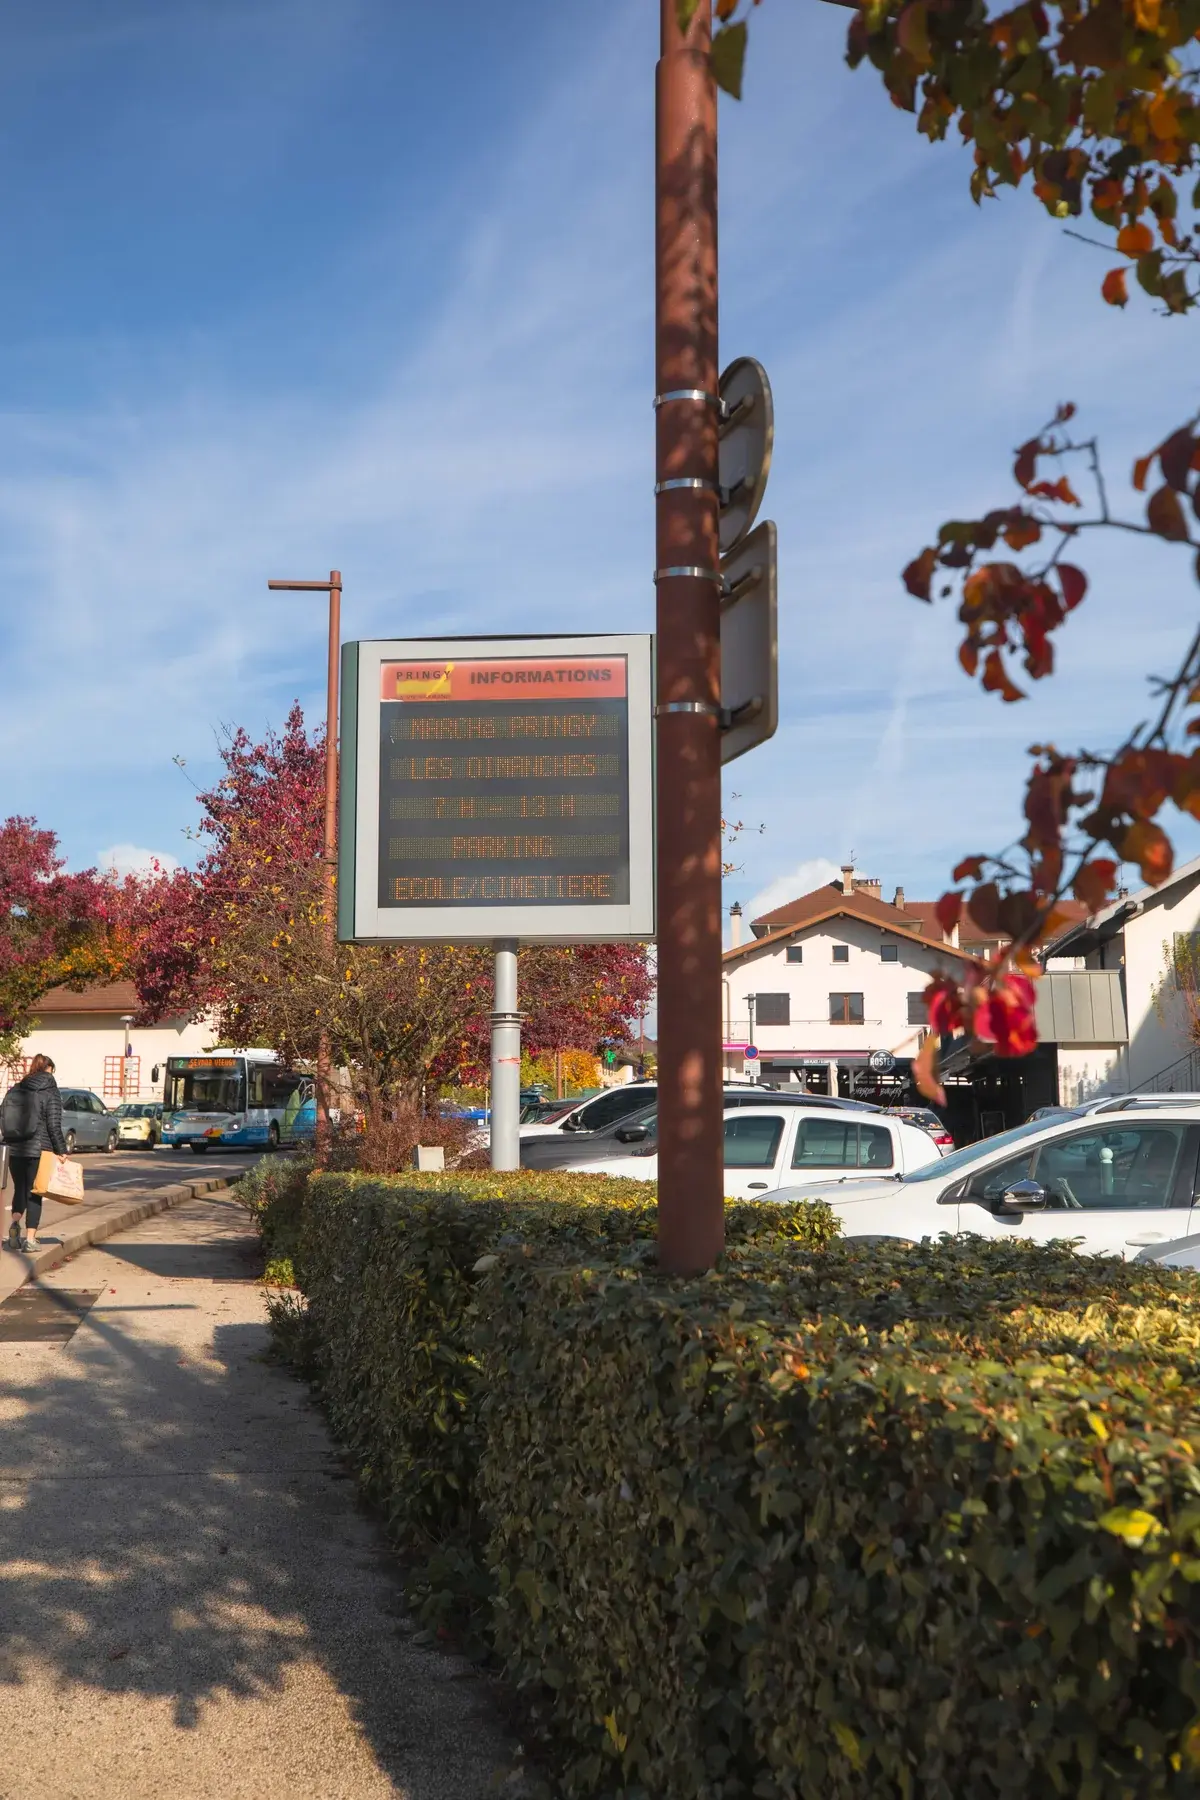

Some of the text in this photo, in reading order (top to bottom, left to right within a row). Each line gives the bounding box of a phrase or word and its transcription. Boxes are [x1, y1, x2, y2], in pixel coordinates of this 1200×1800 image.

[396, 670, 451, 680] PRINGY
[470, 668, 612, 684] INFORMATIONS
[510, 714, 597, 738] PRINGY
[410, 754, 596, 780] LES DIMANCHES
[432, 796, 446, 819] 7
[460, 796, 475, 819] H
[520, 795, 546, 818] 13
[560, 794, 575, 817] H
[453, 836, 553, 859] PARKING
[178, 1060, 184, 1069] 2
